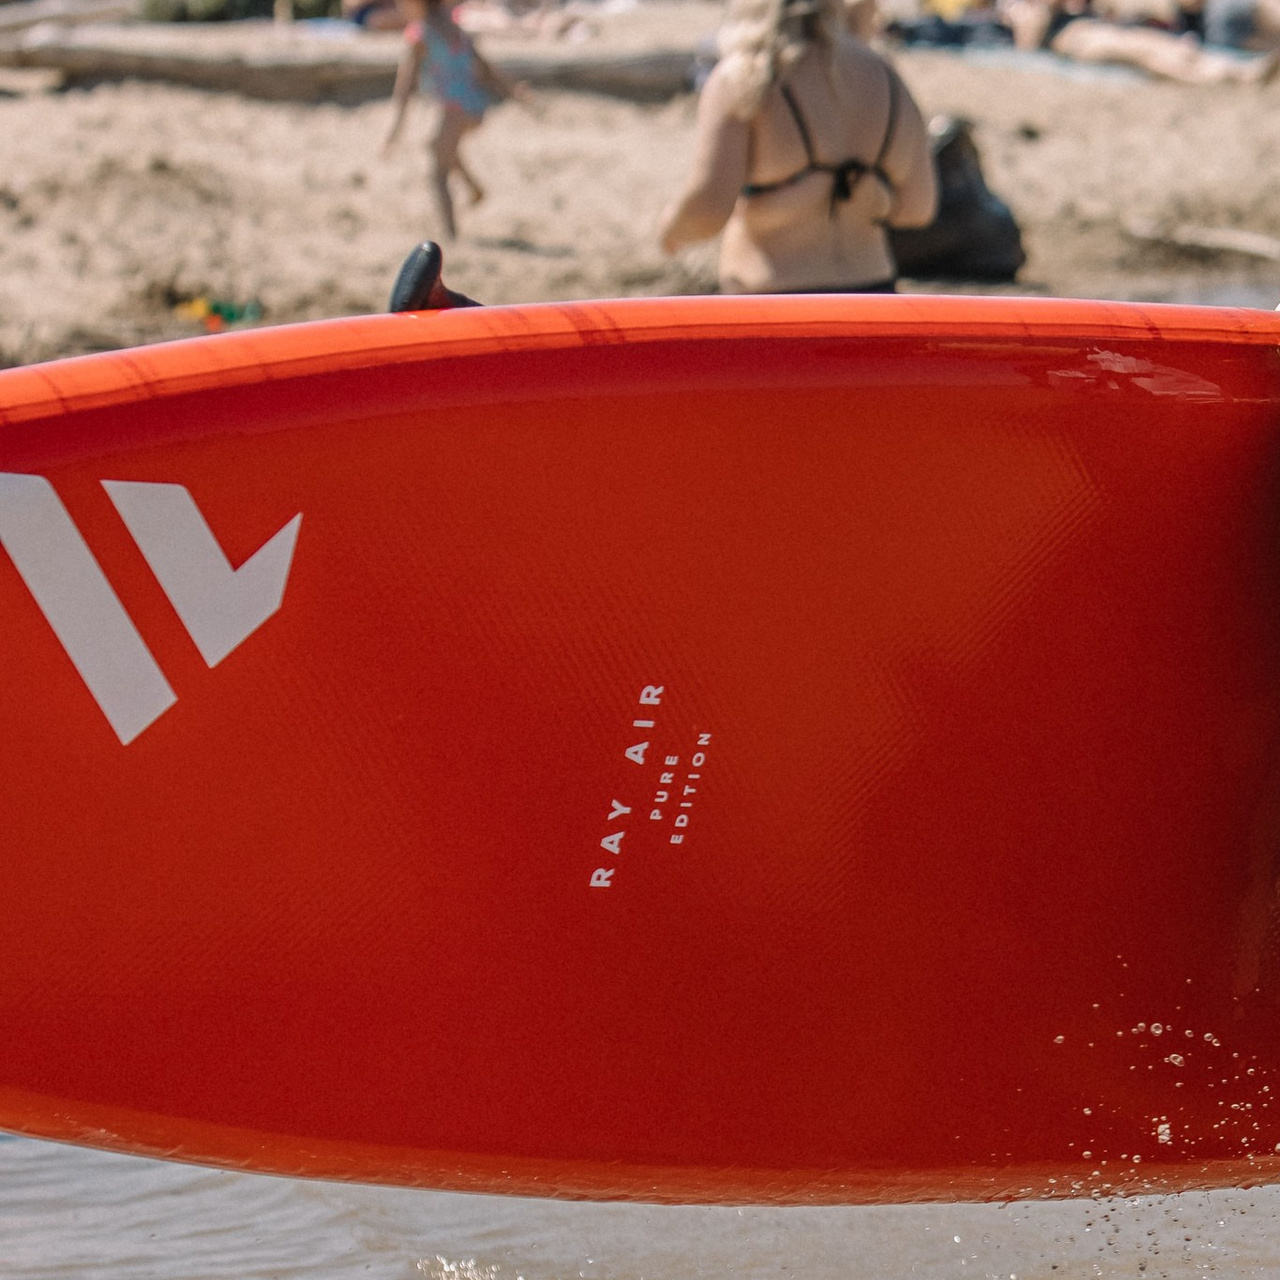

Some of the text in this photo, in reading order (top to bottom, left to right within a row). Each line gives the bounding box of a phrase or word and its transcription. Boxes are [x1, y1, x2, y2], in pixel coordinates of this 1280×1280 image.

[589, 684, 665, 887] RAY AIR
[649, 755, 679, 820] PURE
[669, 733, 712, 844] EDITION
